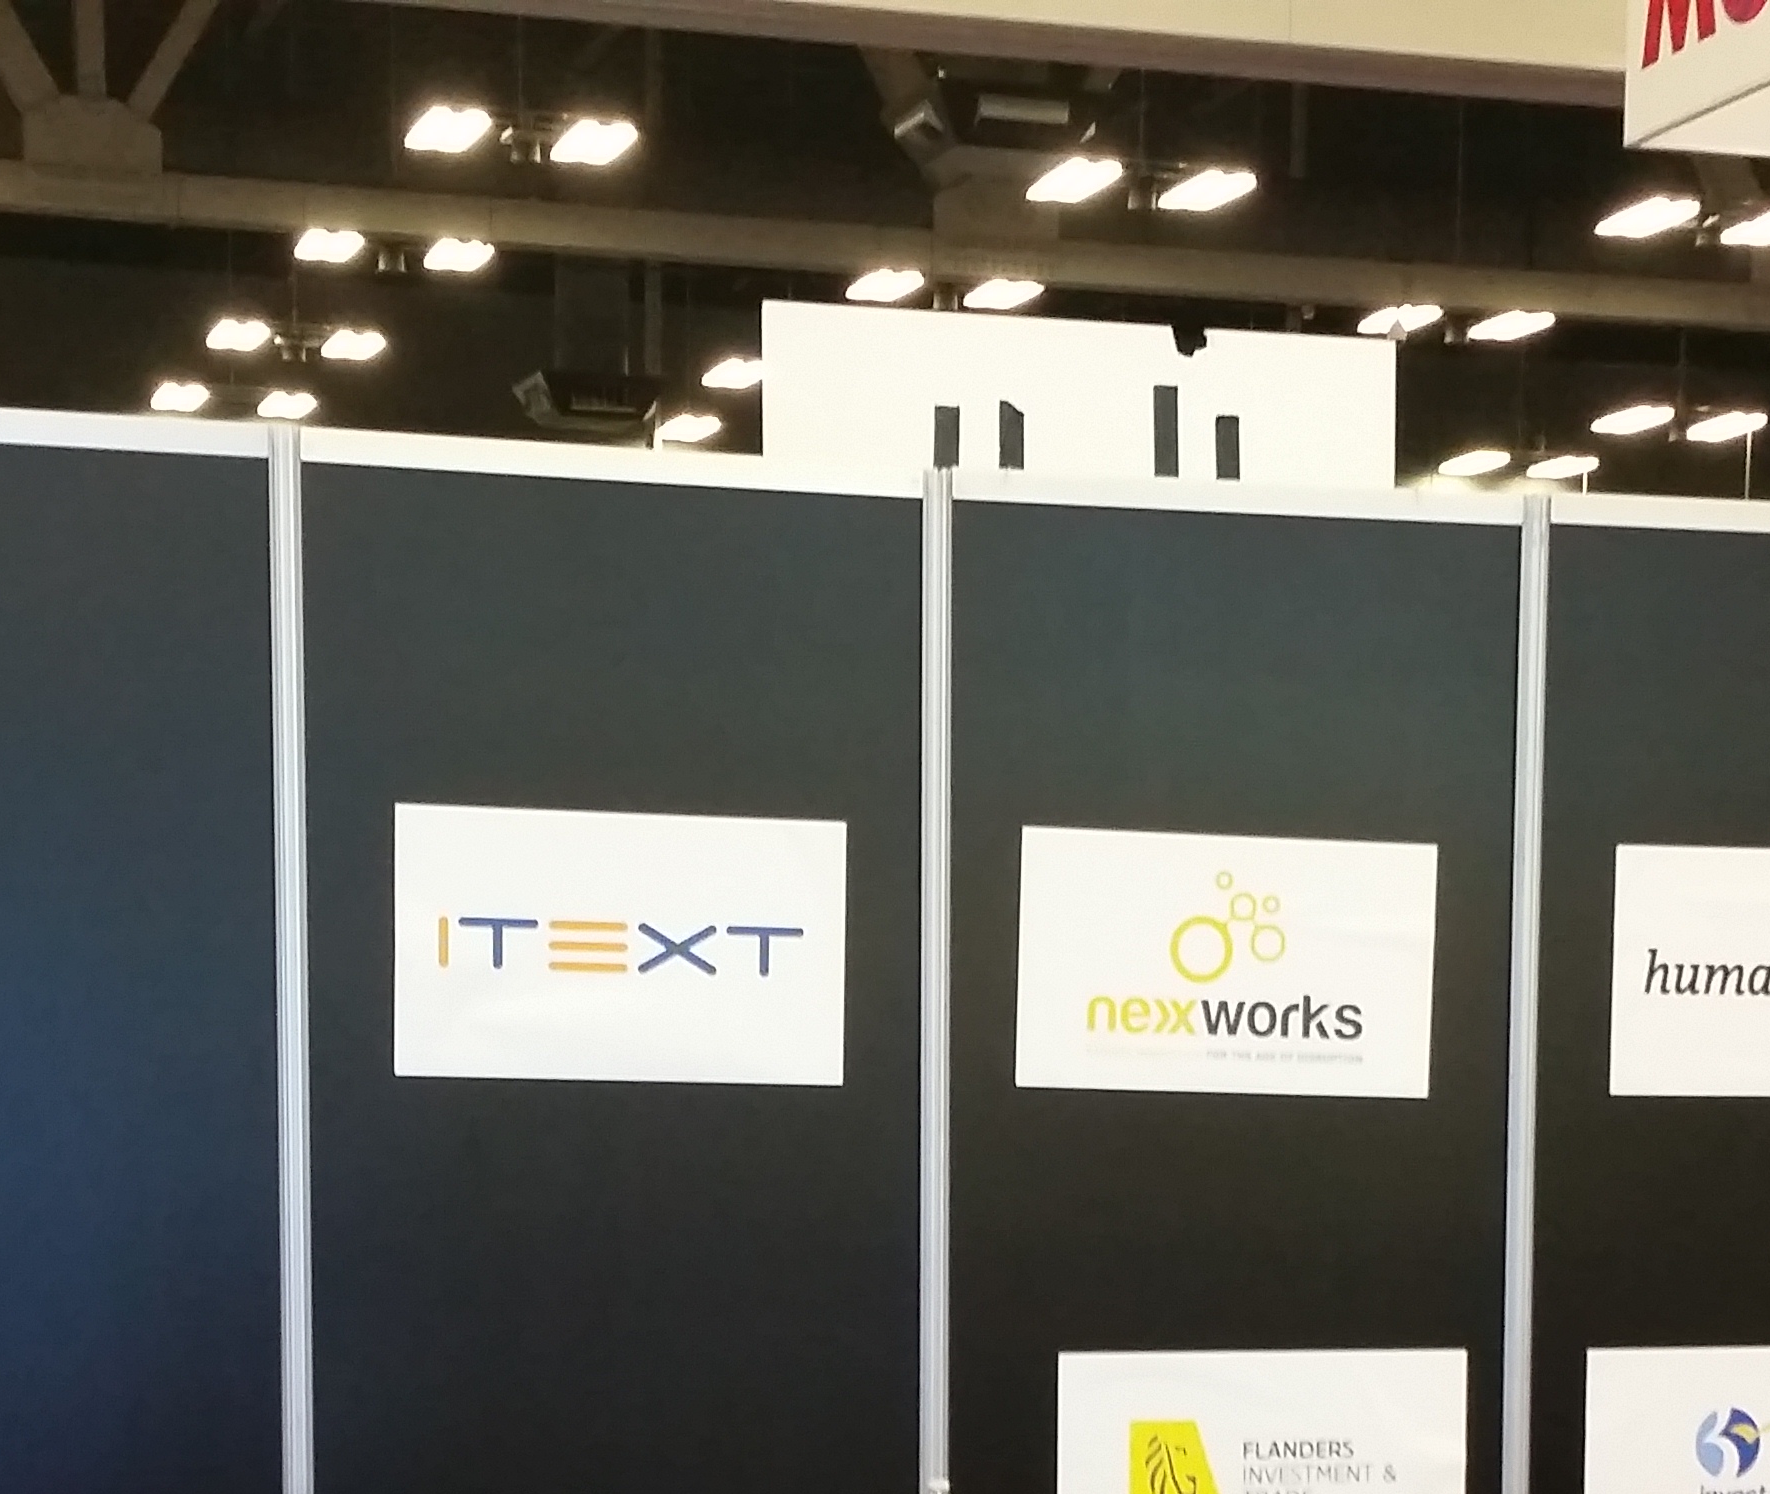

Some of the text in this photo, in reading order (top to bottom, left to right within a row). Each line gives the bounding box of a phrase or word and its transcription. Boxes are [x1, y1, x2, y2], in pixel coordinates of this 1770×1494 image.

[1243, 1441, 1354, 1460] FLANDERS
[1243, 1464, 1397, 1485] INVESTMENT &
